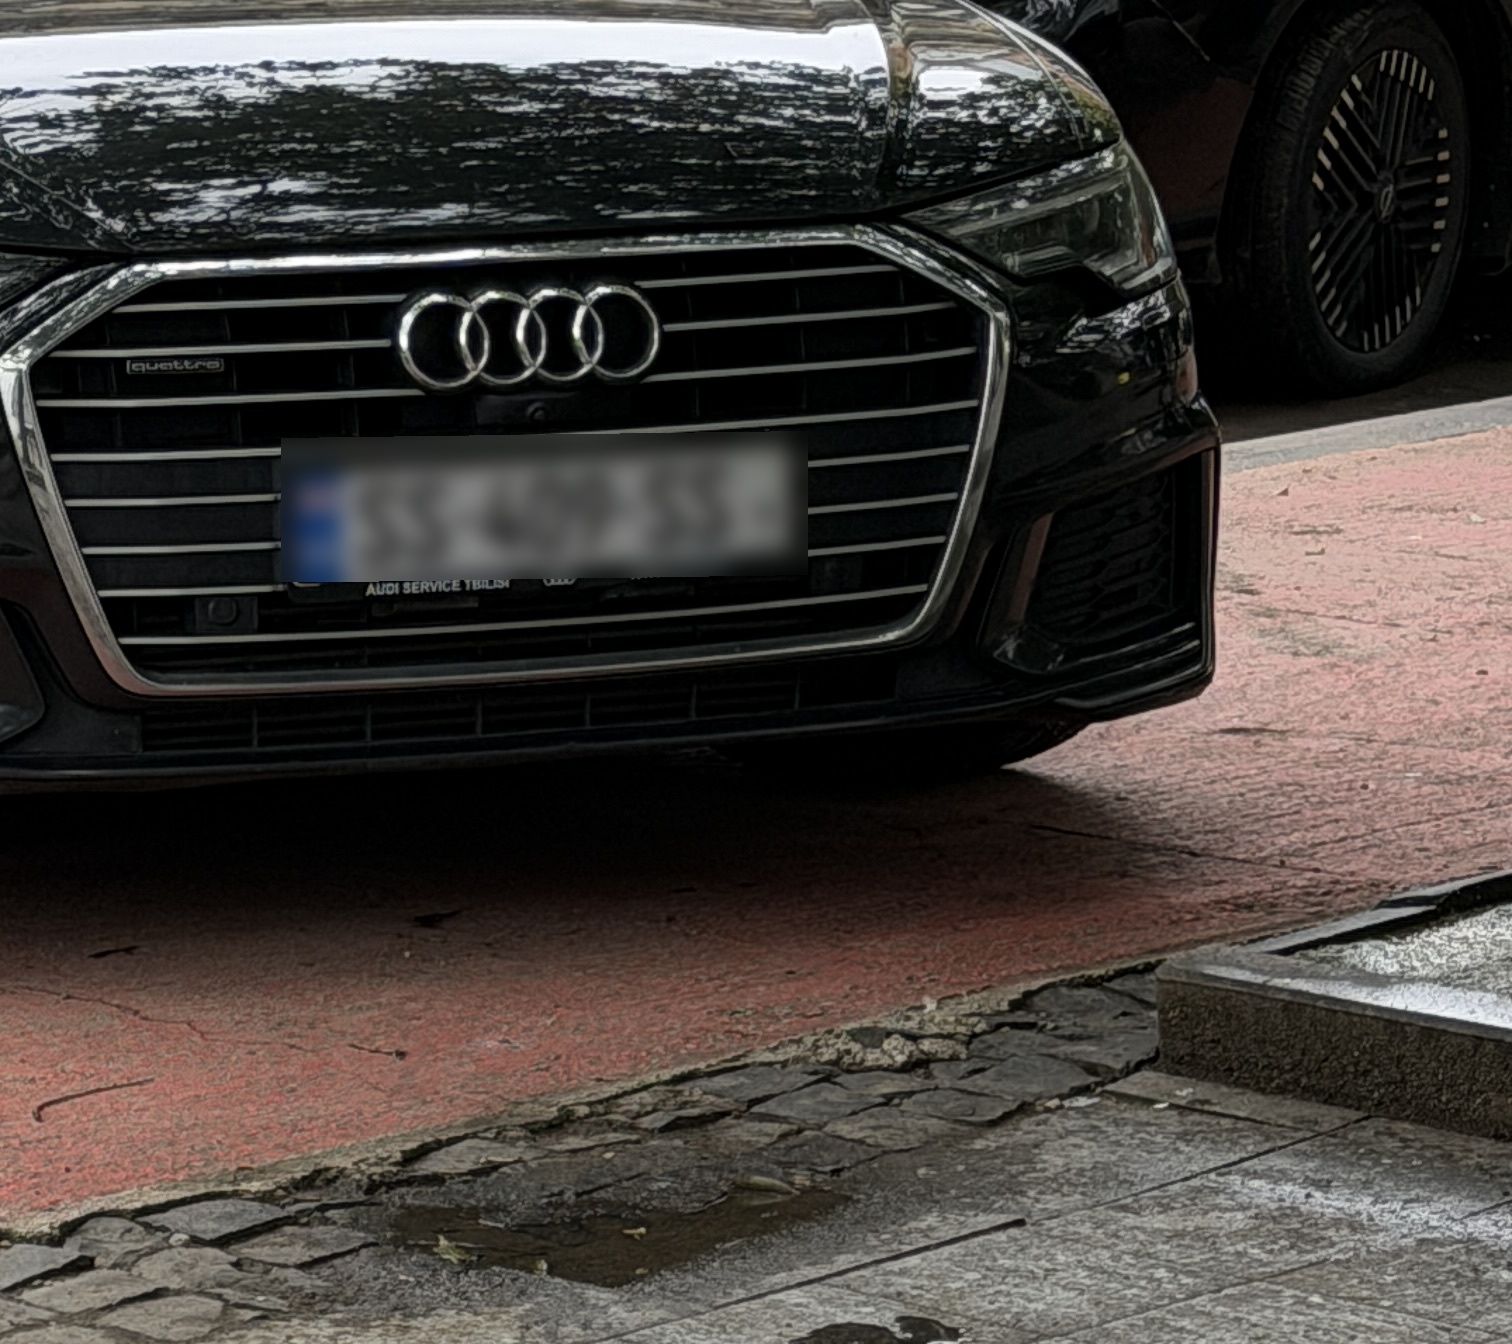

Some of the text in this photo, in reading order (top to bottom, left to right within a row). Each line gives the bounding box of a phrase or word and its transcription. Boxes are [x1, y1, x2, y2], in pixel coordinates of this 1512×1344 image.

[131, 359, 220, 374] quattro
[365, 579, 510, 597] AUDI SERVICE TBILISI
